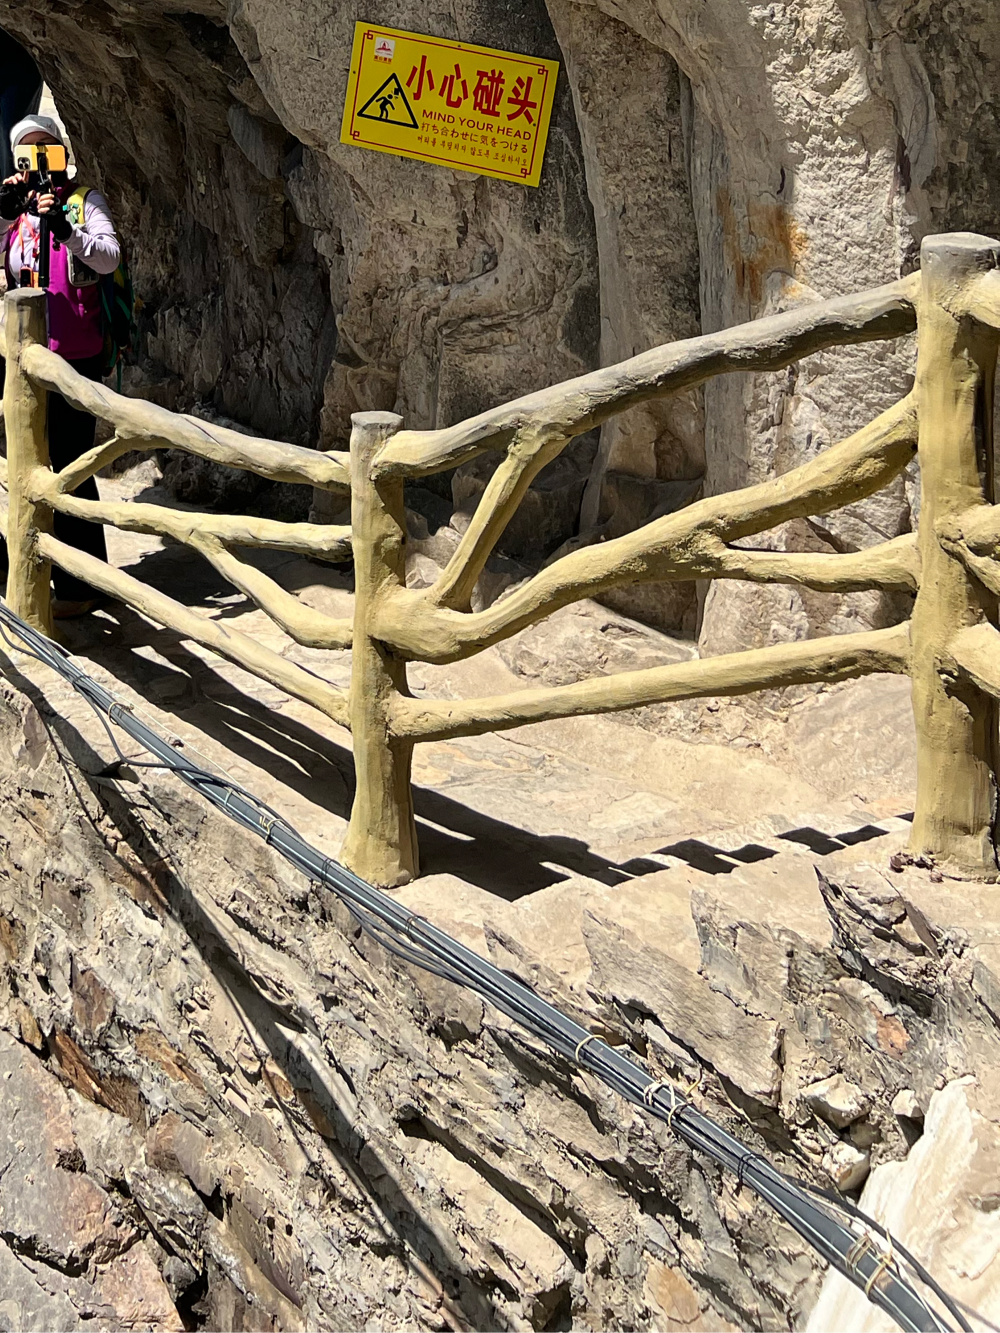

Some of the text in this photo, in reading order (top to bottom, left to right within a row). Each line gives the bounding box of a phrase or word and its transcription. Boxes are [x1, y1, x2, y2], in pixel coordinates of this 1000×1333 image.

[406, 55, 537, 124] 小心碰头
[421, 122, 528, 154] 打ち合わせに気をつける
[422, 109, 532, 141] MIND YOUR HEAD
